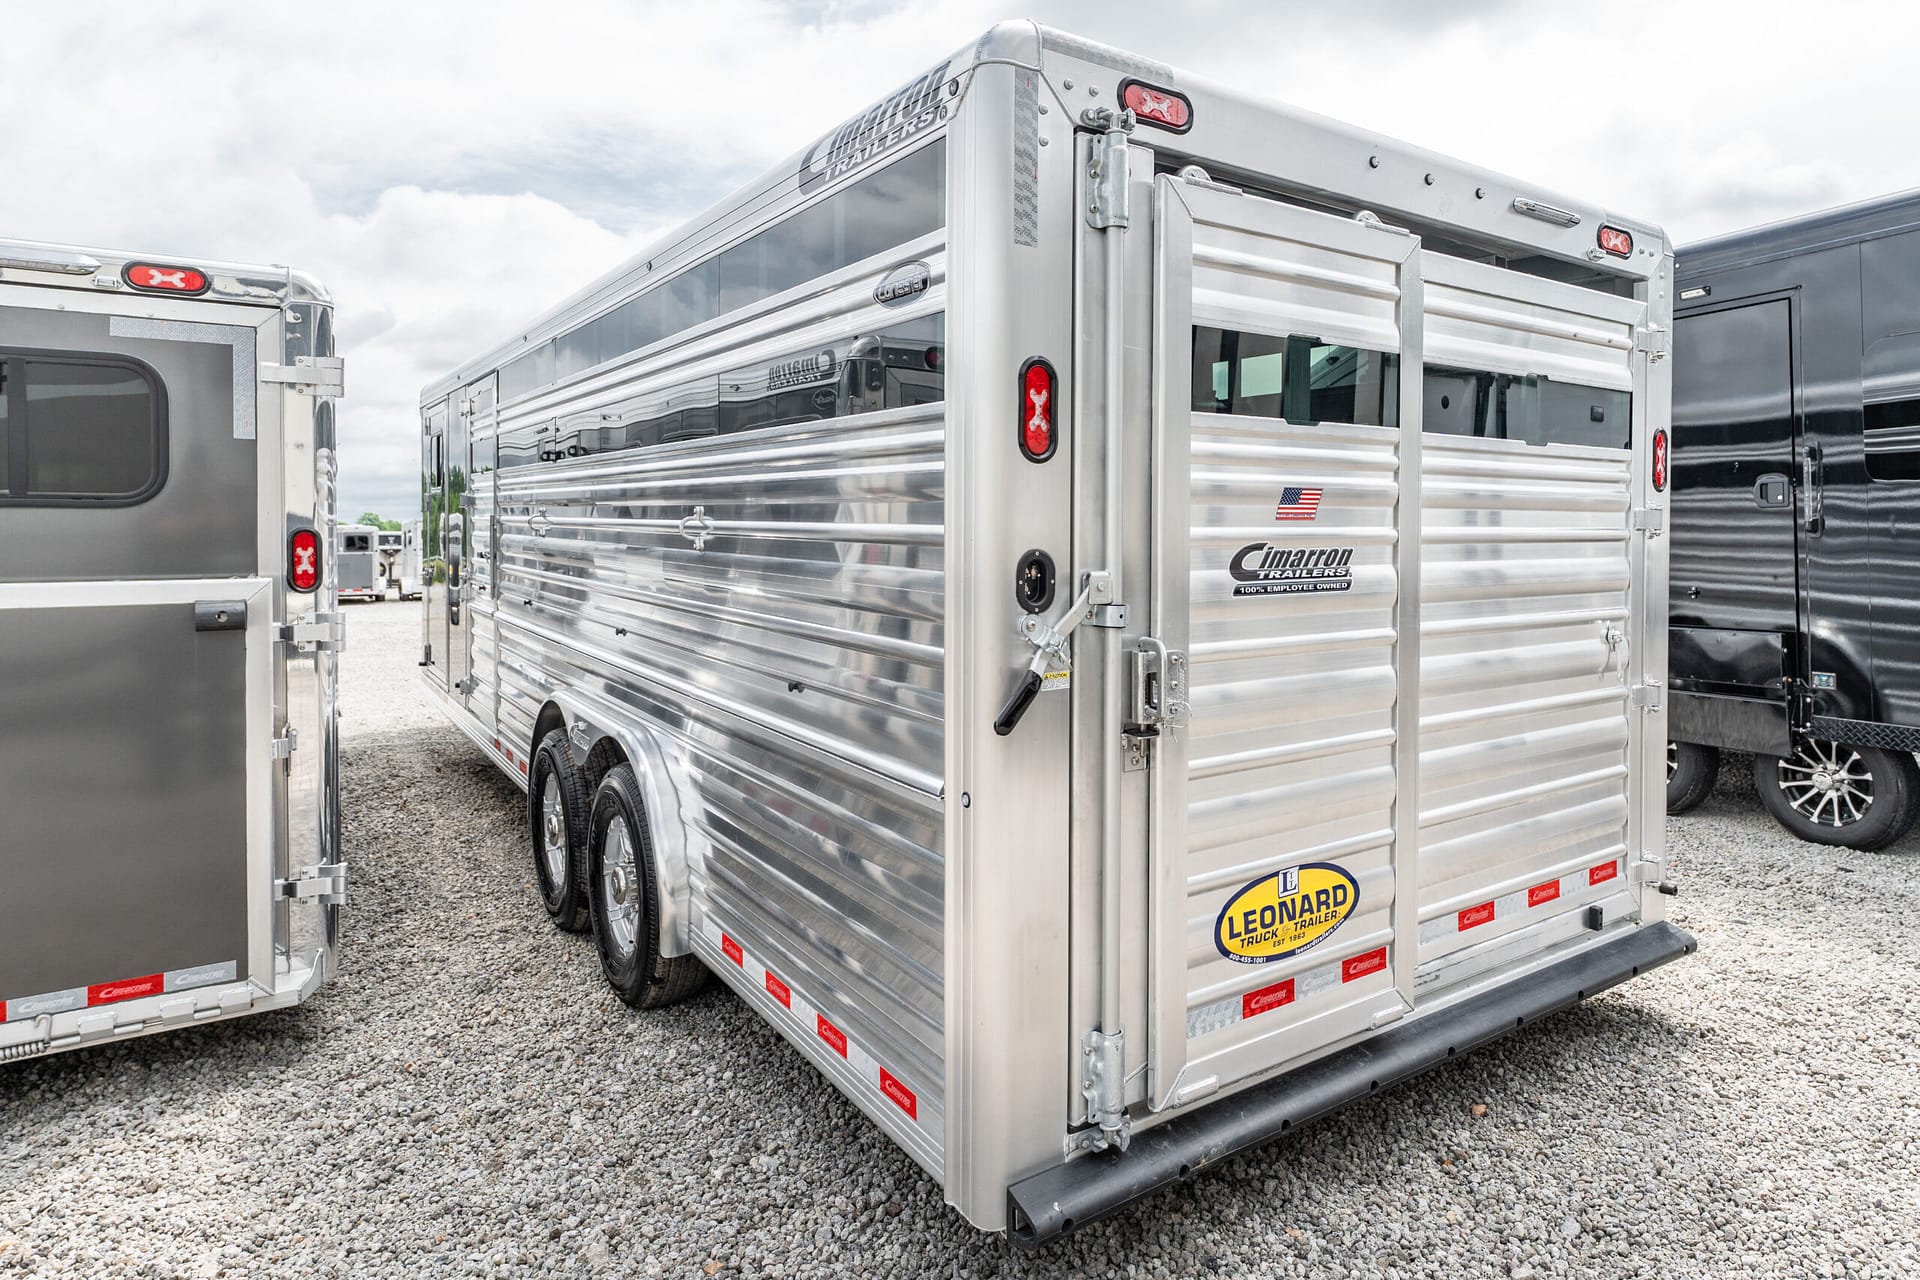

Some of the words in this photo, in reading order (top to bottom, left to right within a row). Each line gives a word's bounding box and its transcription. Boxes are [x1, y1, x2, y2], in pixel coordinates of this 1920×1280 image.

[799, 60, 951, 196] Cimarron
[825, 109, 937, 181] TRAILERS
[1229, 542, 1353, 581] Cimarron
[1257, 567, 1347, 579] TRAILERS
[1240, 586, 1265, 594] 100%
[1267, 584, 1315, 593] EMPLOYEE
[1316, 582, 1348, 590] OWNED
[1228, 883, 1348, 940] LEONARD
[1240, 927, 1279, 949] TRUCK
[1293, 910, 1338, 932] TRAILER
[1273, 938, 1286, 948] EST
